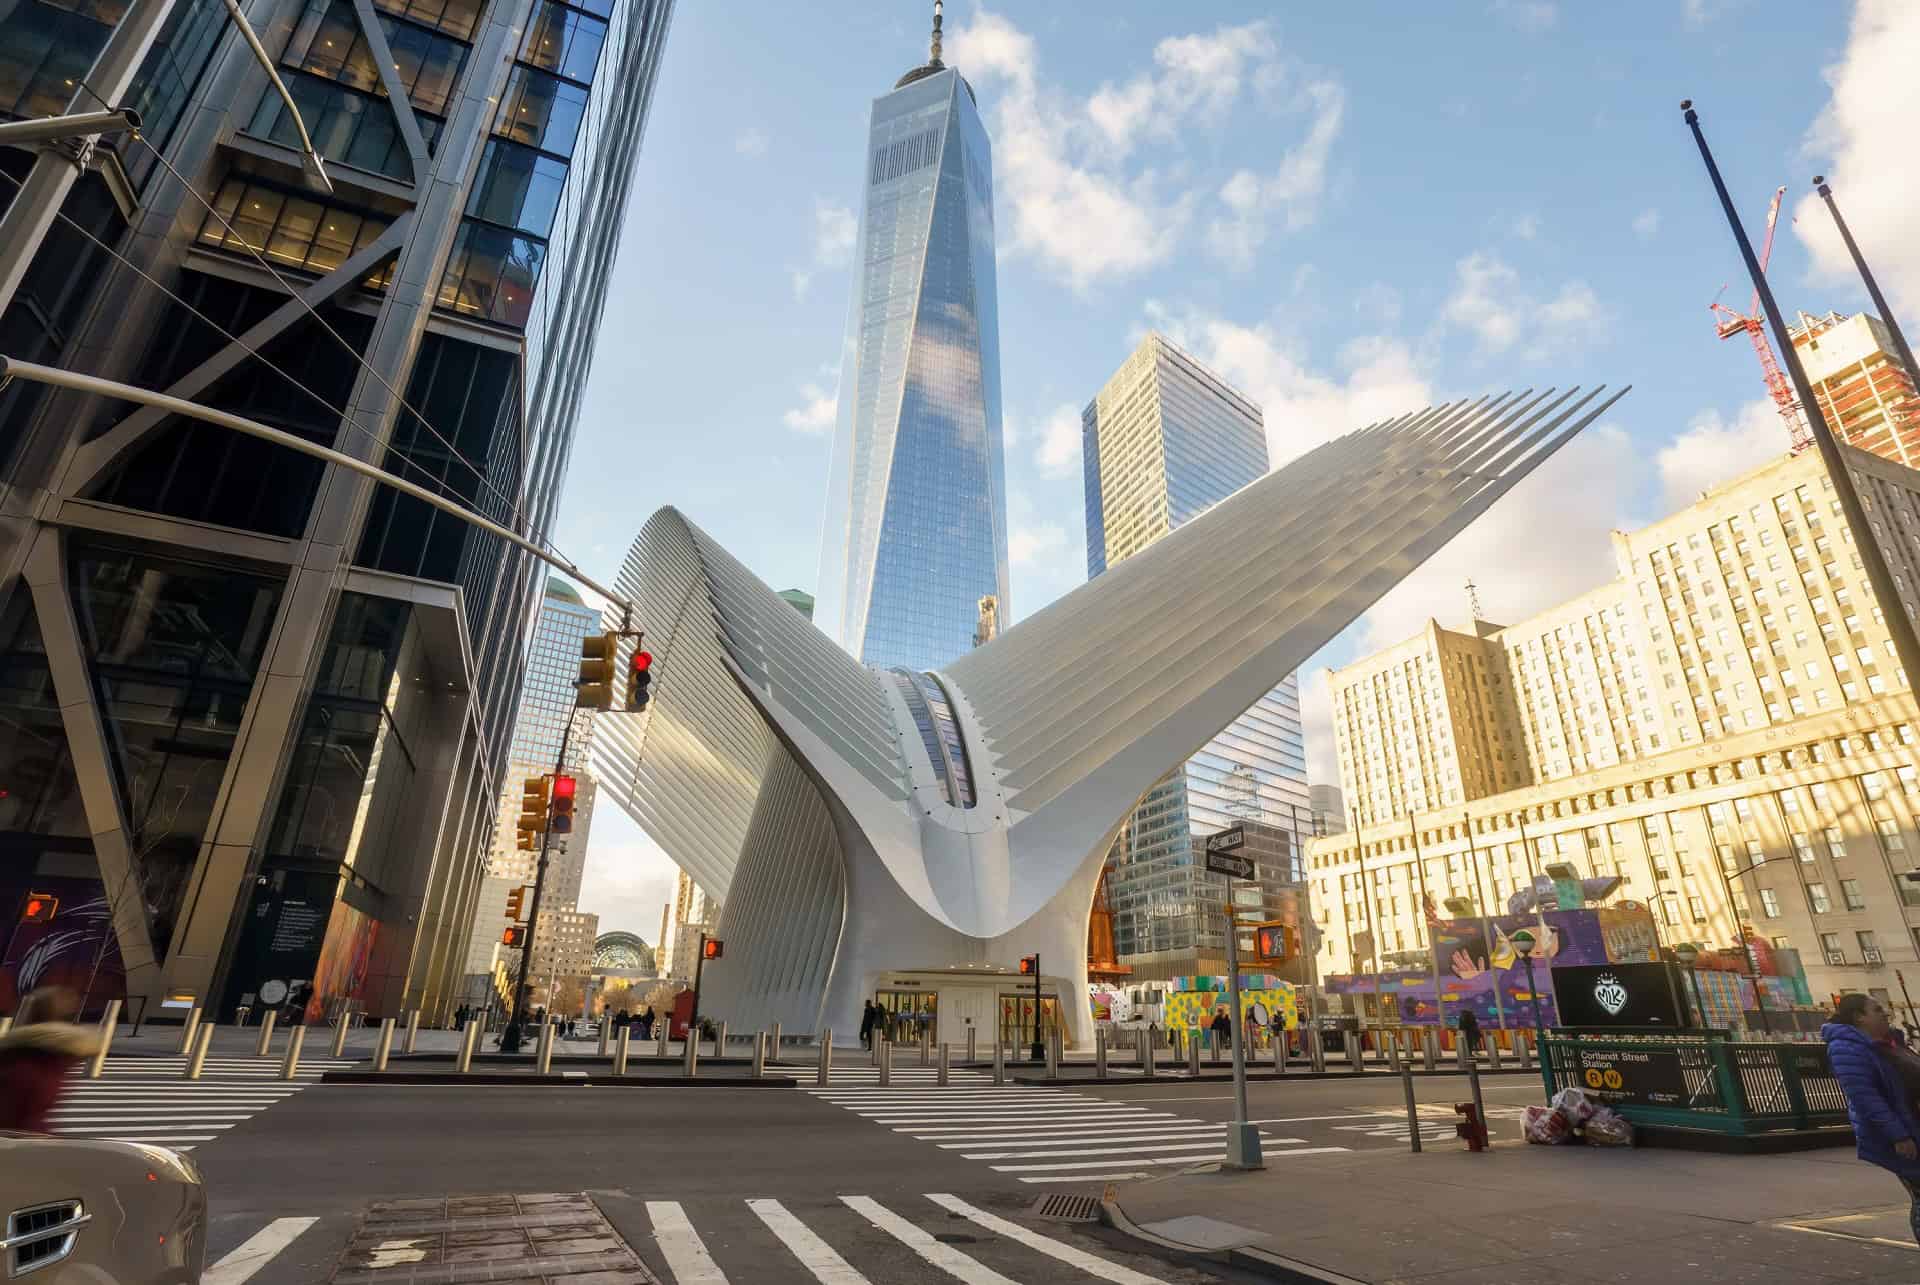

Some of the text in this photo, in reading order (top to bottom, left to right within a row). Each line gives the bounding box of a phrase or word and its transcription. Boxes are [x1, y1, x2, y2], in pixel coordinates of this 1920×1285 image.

[1580, 1049, 1649, 1062] Cortlandt Street
[1582, 1060, 1613, 1069] Station
